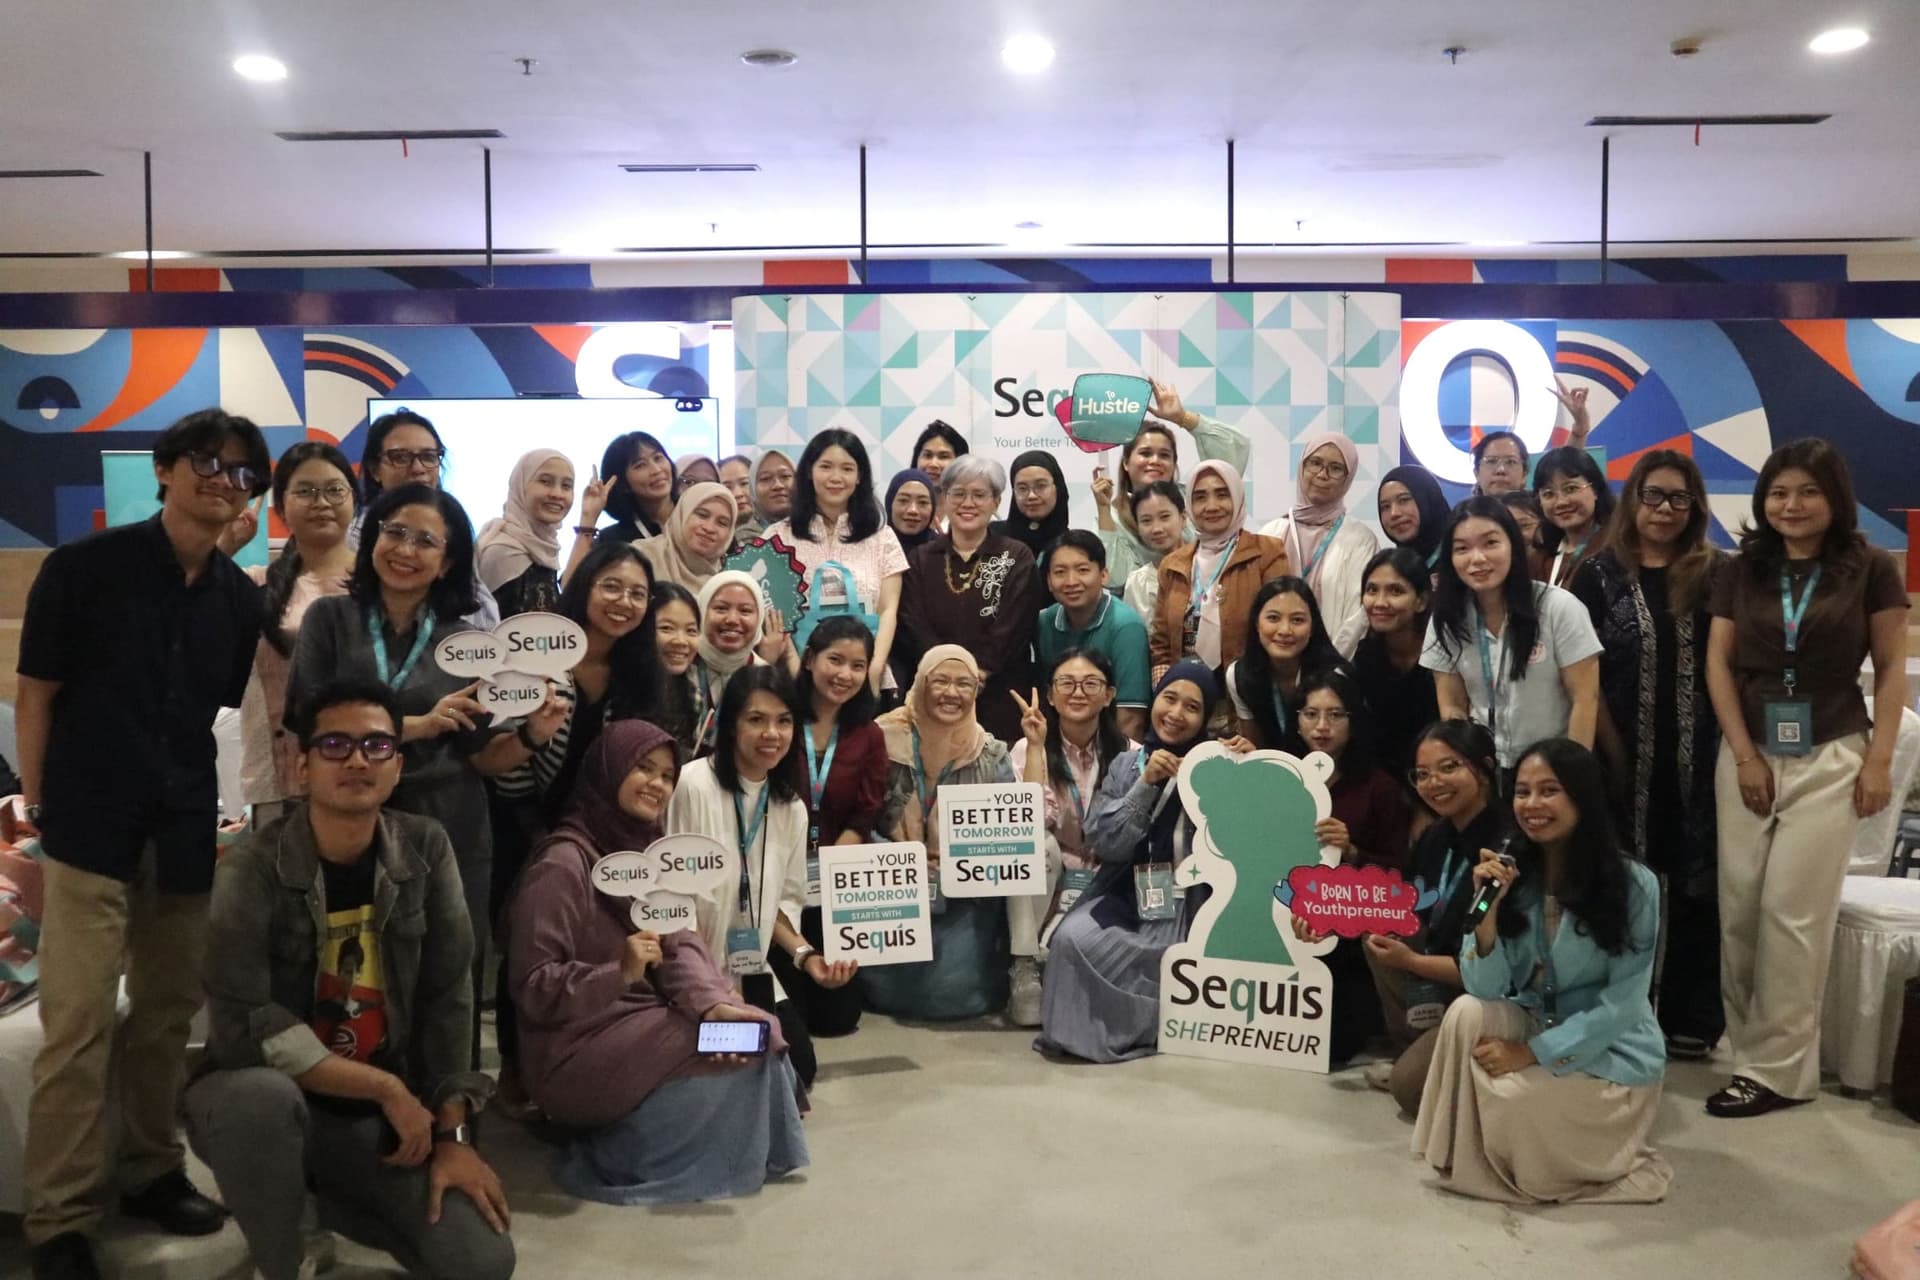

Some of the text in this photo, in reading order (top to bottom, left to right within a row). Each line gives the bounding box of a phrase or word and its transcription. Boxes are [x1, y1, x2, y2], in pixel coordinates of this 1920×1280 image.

[1078, 397, 1141, 416] Hustle
[994, 436, 1021, 448] Your
[1025, 436, 1061, 448] Better
[508, 631, 577, 655] Sequis
[444, 645, 497, 663] Sequis
[488, 686, 540, 702] Sequis
[993, 793, 1033, 805] YOUR
[952, 807, 1034, 825] BETTER
[953, 826, 1034, 838] TOMORROW
[967, 845, 1017, 854] STARTS WITH
[660, 851, 724, 875] Sequis
[876, 853, 917, 866] YOUR
[601, 866, 649, 883] Sequis
[835, 868, 918, 889] BETTER
[956, 858, 1031, 886] Sequis
[836, 888, 918, 904] TOMORROW
[1373, 886, 1387, 903] BE
[641, 904, 689, 921] Sequis
[850, 909, 902, 920] STARTS WITH
[1303, 901, 1408, 920] Youthpreneur
[839, 922, 916, 954] Sequis
[1170, 958, 1323, 1025] Sequis
[1165, 1018, 1321, 1056] SHEPRENEUR
